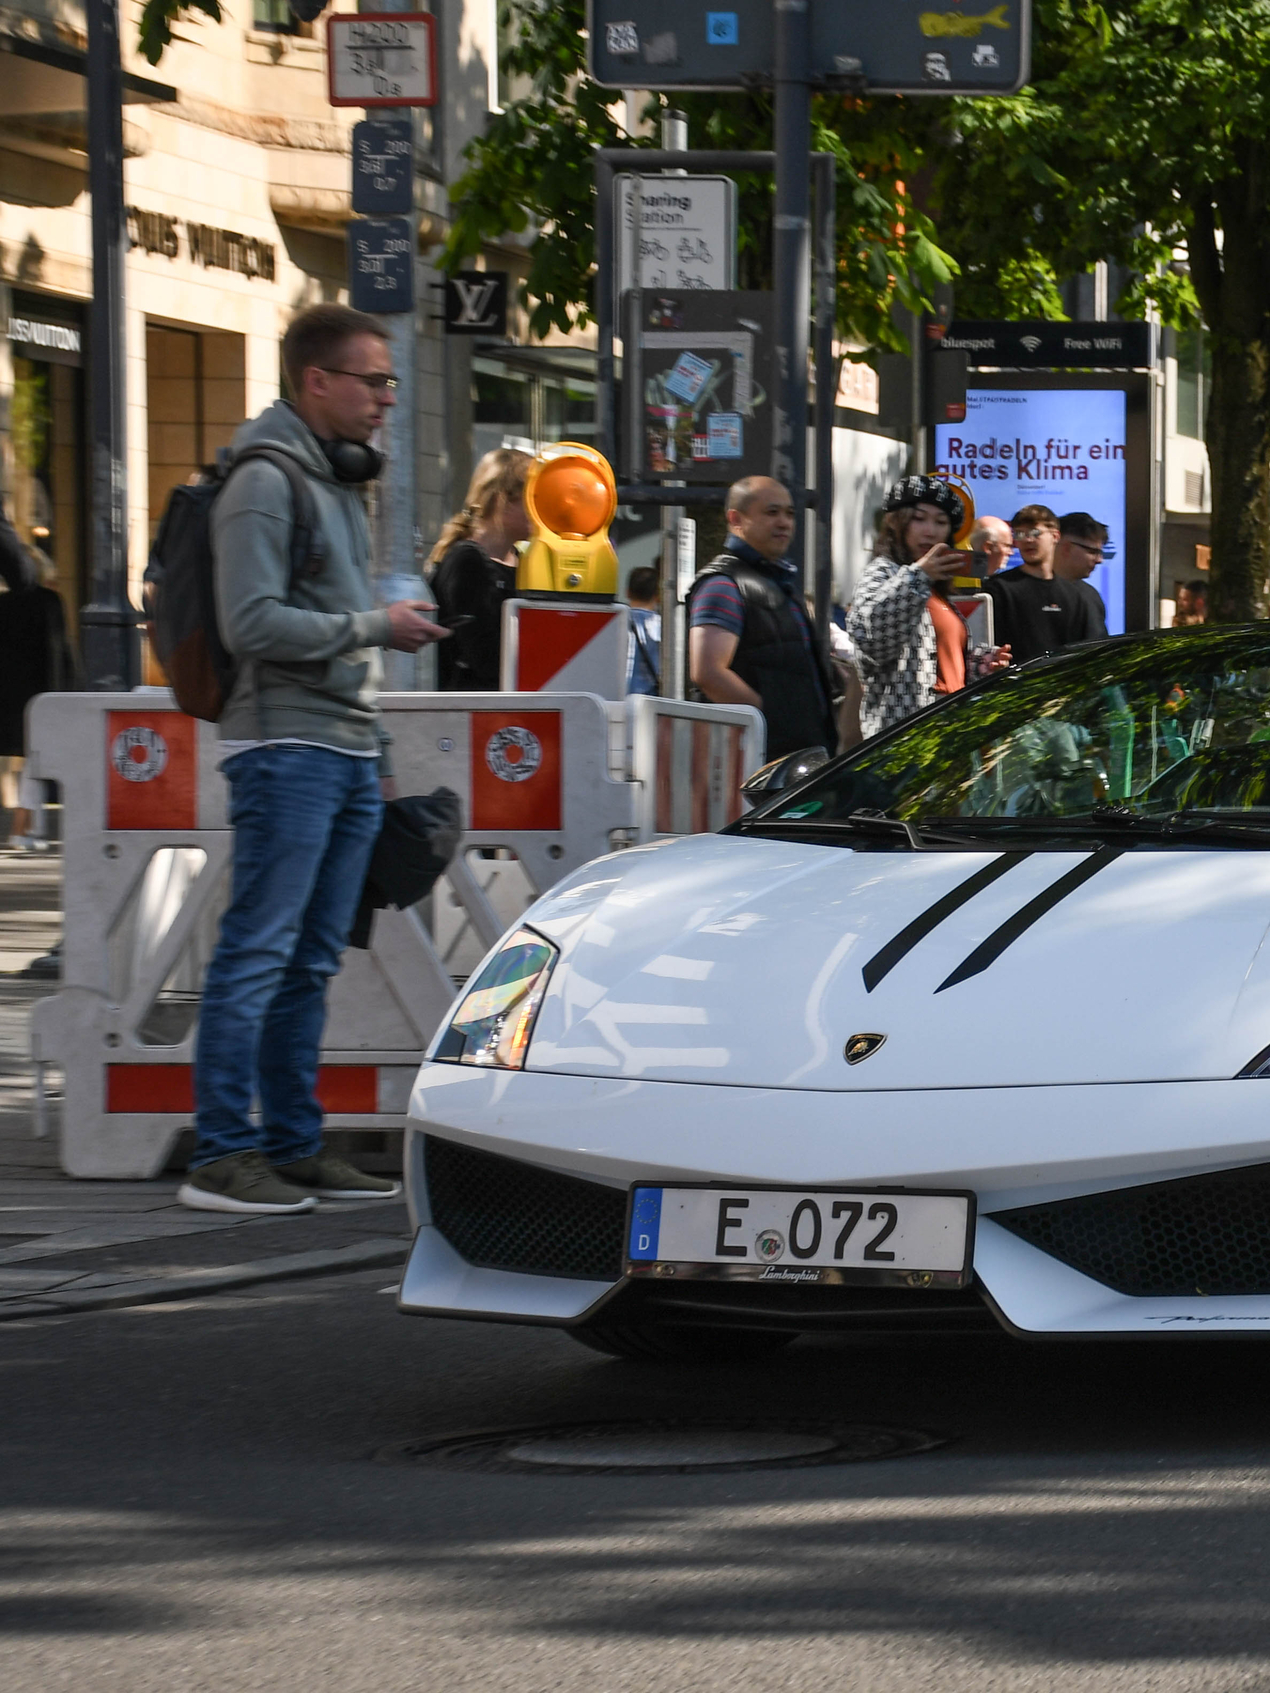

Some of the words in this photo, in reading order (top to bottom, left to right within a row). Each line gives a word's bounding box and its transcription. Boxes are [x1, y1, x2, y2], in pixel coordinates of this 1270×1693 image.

[624, 208, 684, 224] Sation
[940, 336, 996, 351] bluespot
[1064, 337, 1091, 349] Free
[947, 437, 1037, 460] Radeln
[1045, 438, 1082, 461] für
[935, 460, 1009, 482] gutes
[1016, 459, 1089, 480] Klima
[715, 1198, 749, 1257] E
[789, 1198, 898, 1261] 072
[638, 1234, 650, 1251] D
[758, 1265, 821, 1283] Lamborghini
